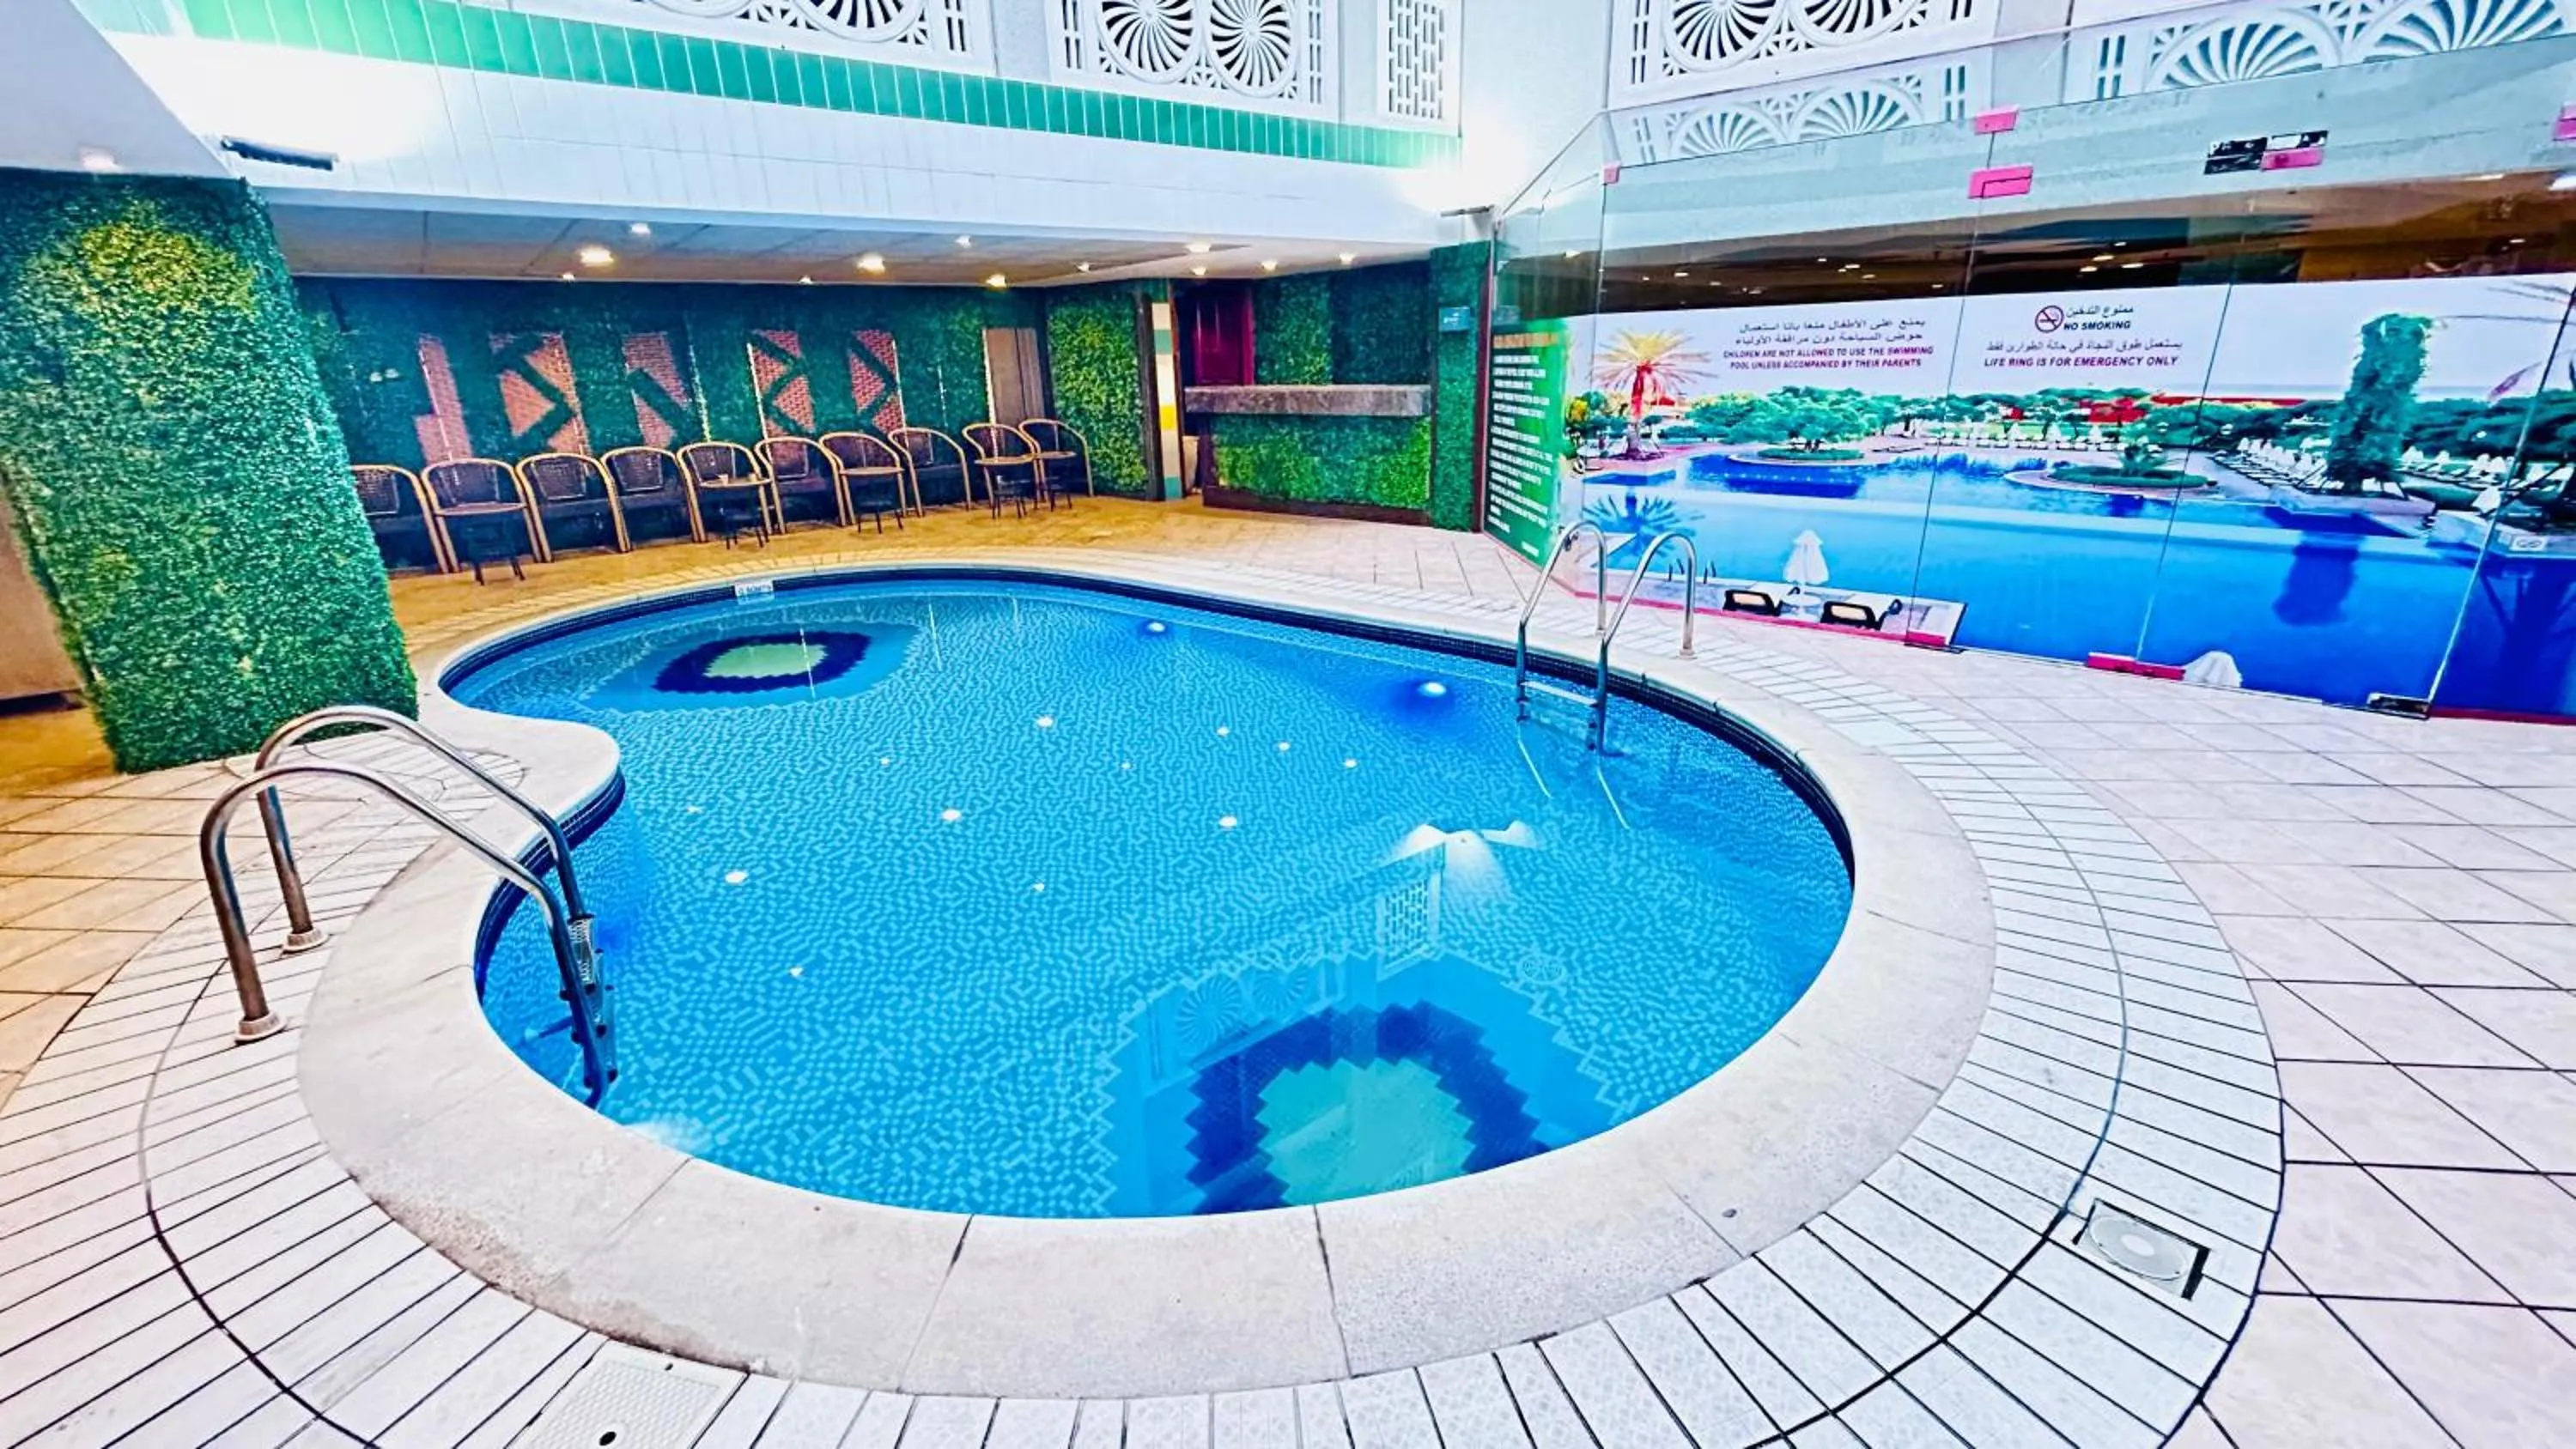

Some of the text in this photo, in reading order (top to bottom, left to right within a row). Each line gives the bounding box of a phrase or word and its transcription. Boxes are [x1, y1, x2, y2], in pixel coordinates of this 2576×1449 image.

[2063, 320, 2131, 330] NO SMOKING
[1723, 349, 1761, 359] CHILDREN
[1762, 349, 1777, 358] ARE
[1797, 348, 1835, 357] ALLOWED
[1837, 348, 1848, 356] TO
[1850, 348, 1866, 356] USE
[1868, 347, 1885, 355] THE
[1887, 346, 1934, 355] SWIMMING
[1730, 361, 1750, 370] POOL
[1752, 361, 1782, 369] UNLESS
[1783, 360, 1839, 369] ACCOMPANIED
[1841, 360, 1853, 368] BY
[1882, 358, 1922, 367] PARENTS
[1984, 356, 2178, 367] LIFE RING IS FOR EMERGENCY ONLY
